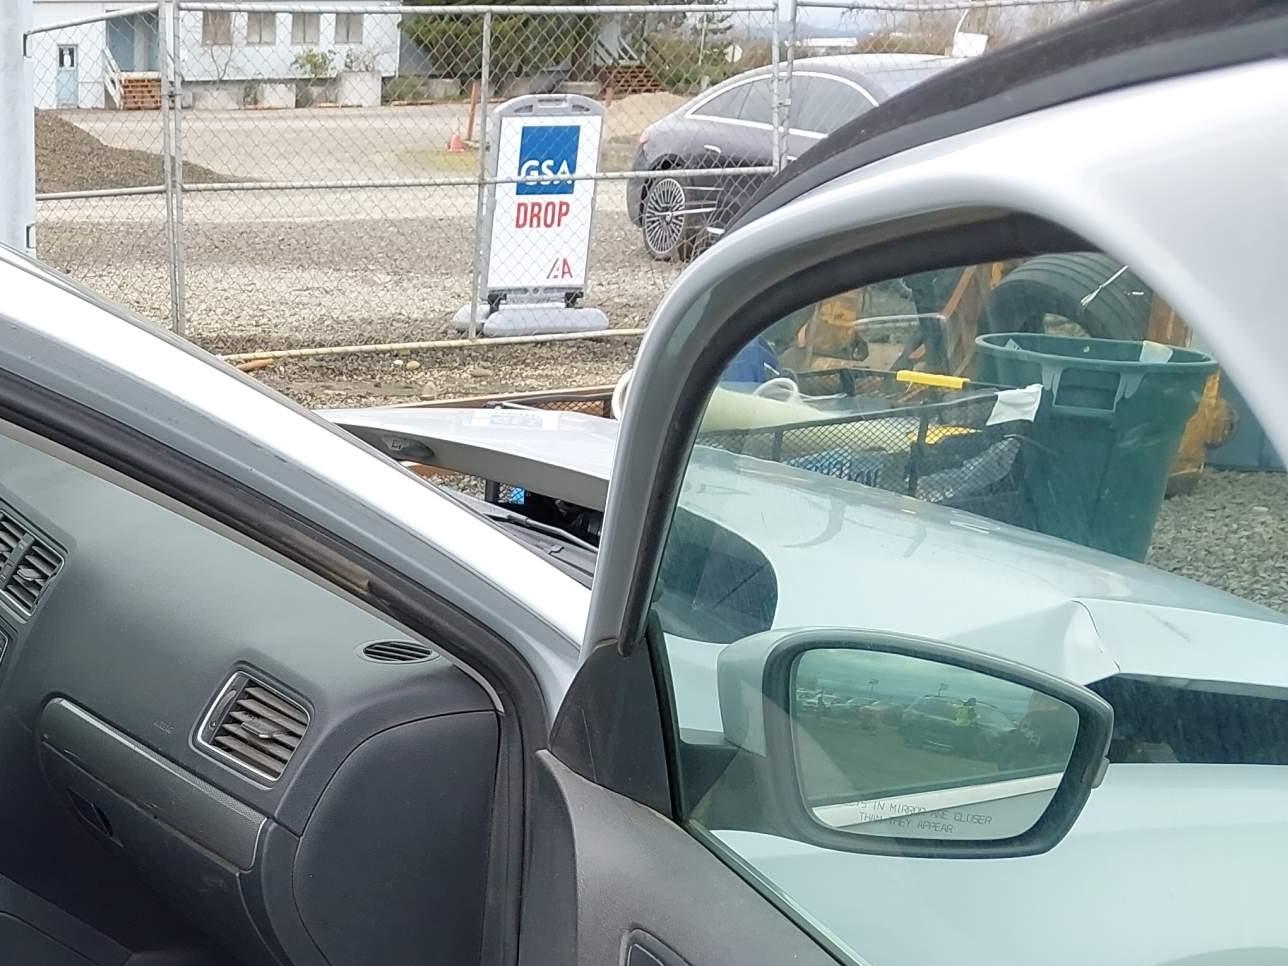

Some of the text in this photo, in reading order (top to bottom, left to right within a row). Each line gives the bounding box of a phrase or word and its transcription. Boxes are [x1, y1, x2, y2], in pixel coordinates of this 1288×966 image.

[520, 159, 572, 186] GSA
[515, 201, 570, 229] DROP
[873, 800, 886, 812] IN
[953, 814, 993, 826] CLOSER
[916, 822, 954, 834] APPEAR
